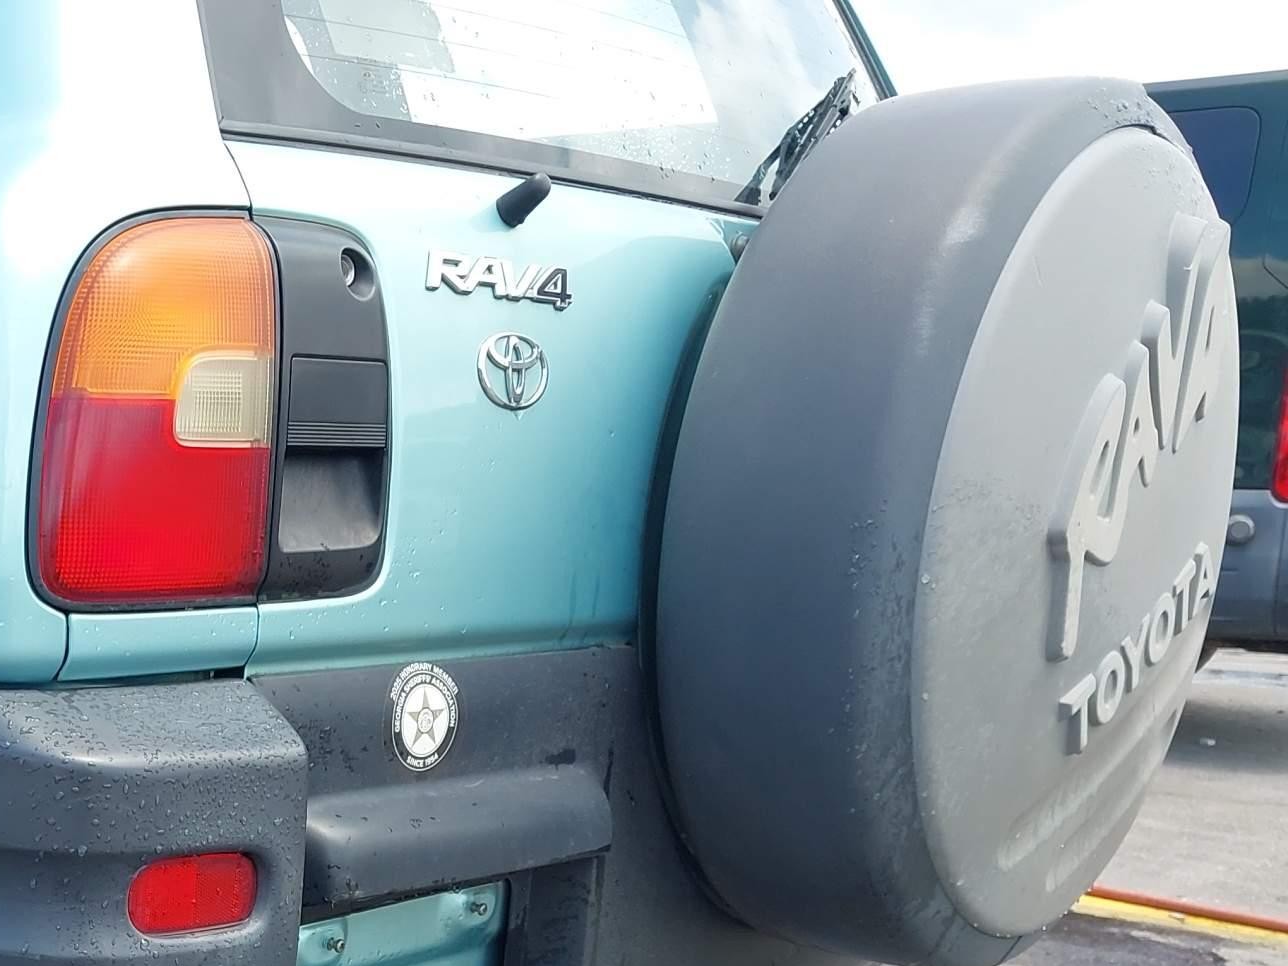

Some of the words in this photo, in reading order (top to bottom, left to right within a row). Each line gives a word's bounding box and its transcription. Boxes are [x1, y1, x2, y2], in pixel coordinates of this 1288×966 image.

[425, 250, 572, 312] RAV4
[1058, 541, 1214, 755] TOYOTA
[394, 691, 407, 733] GEORGIA
[431, 676, 456, 728] ASSOCIATION
[399, 662, 432, 681] HONORARY
[433, 663, 460, 696] MEMBER
